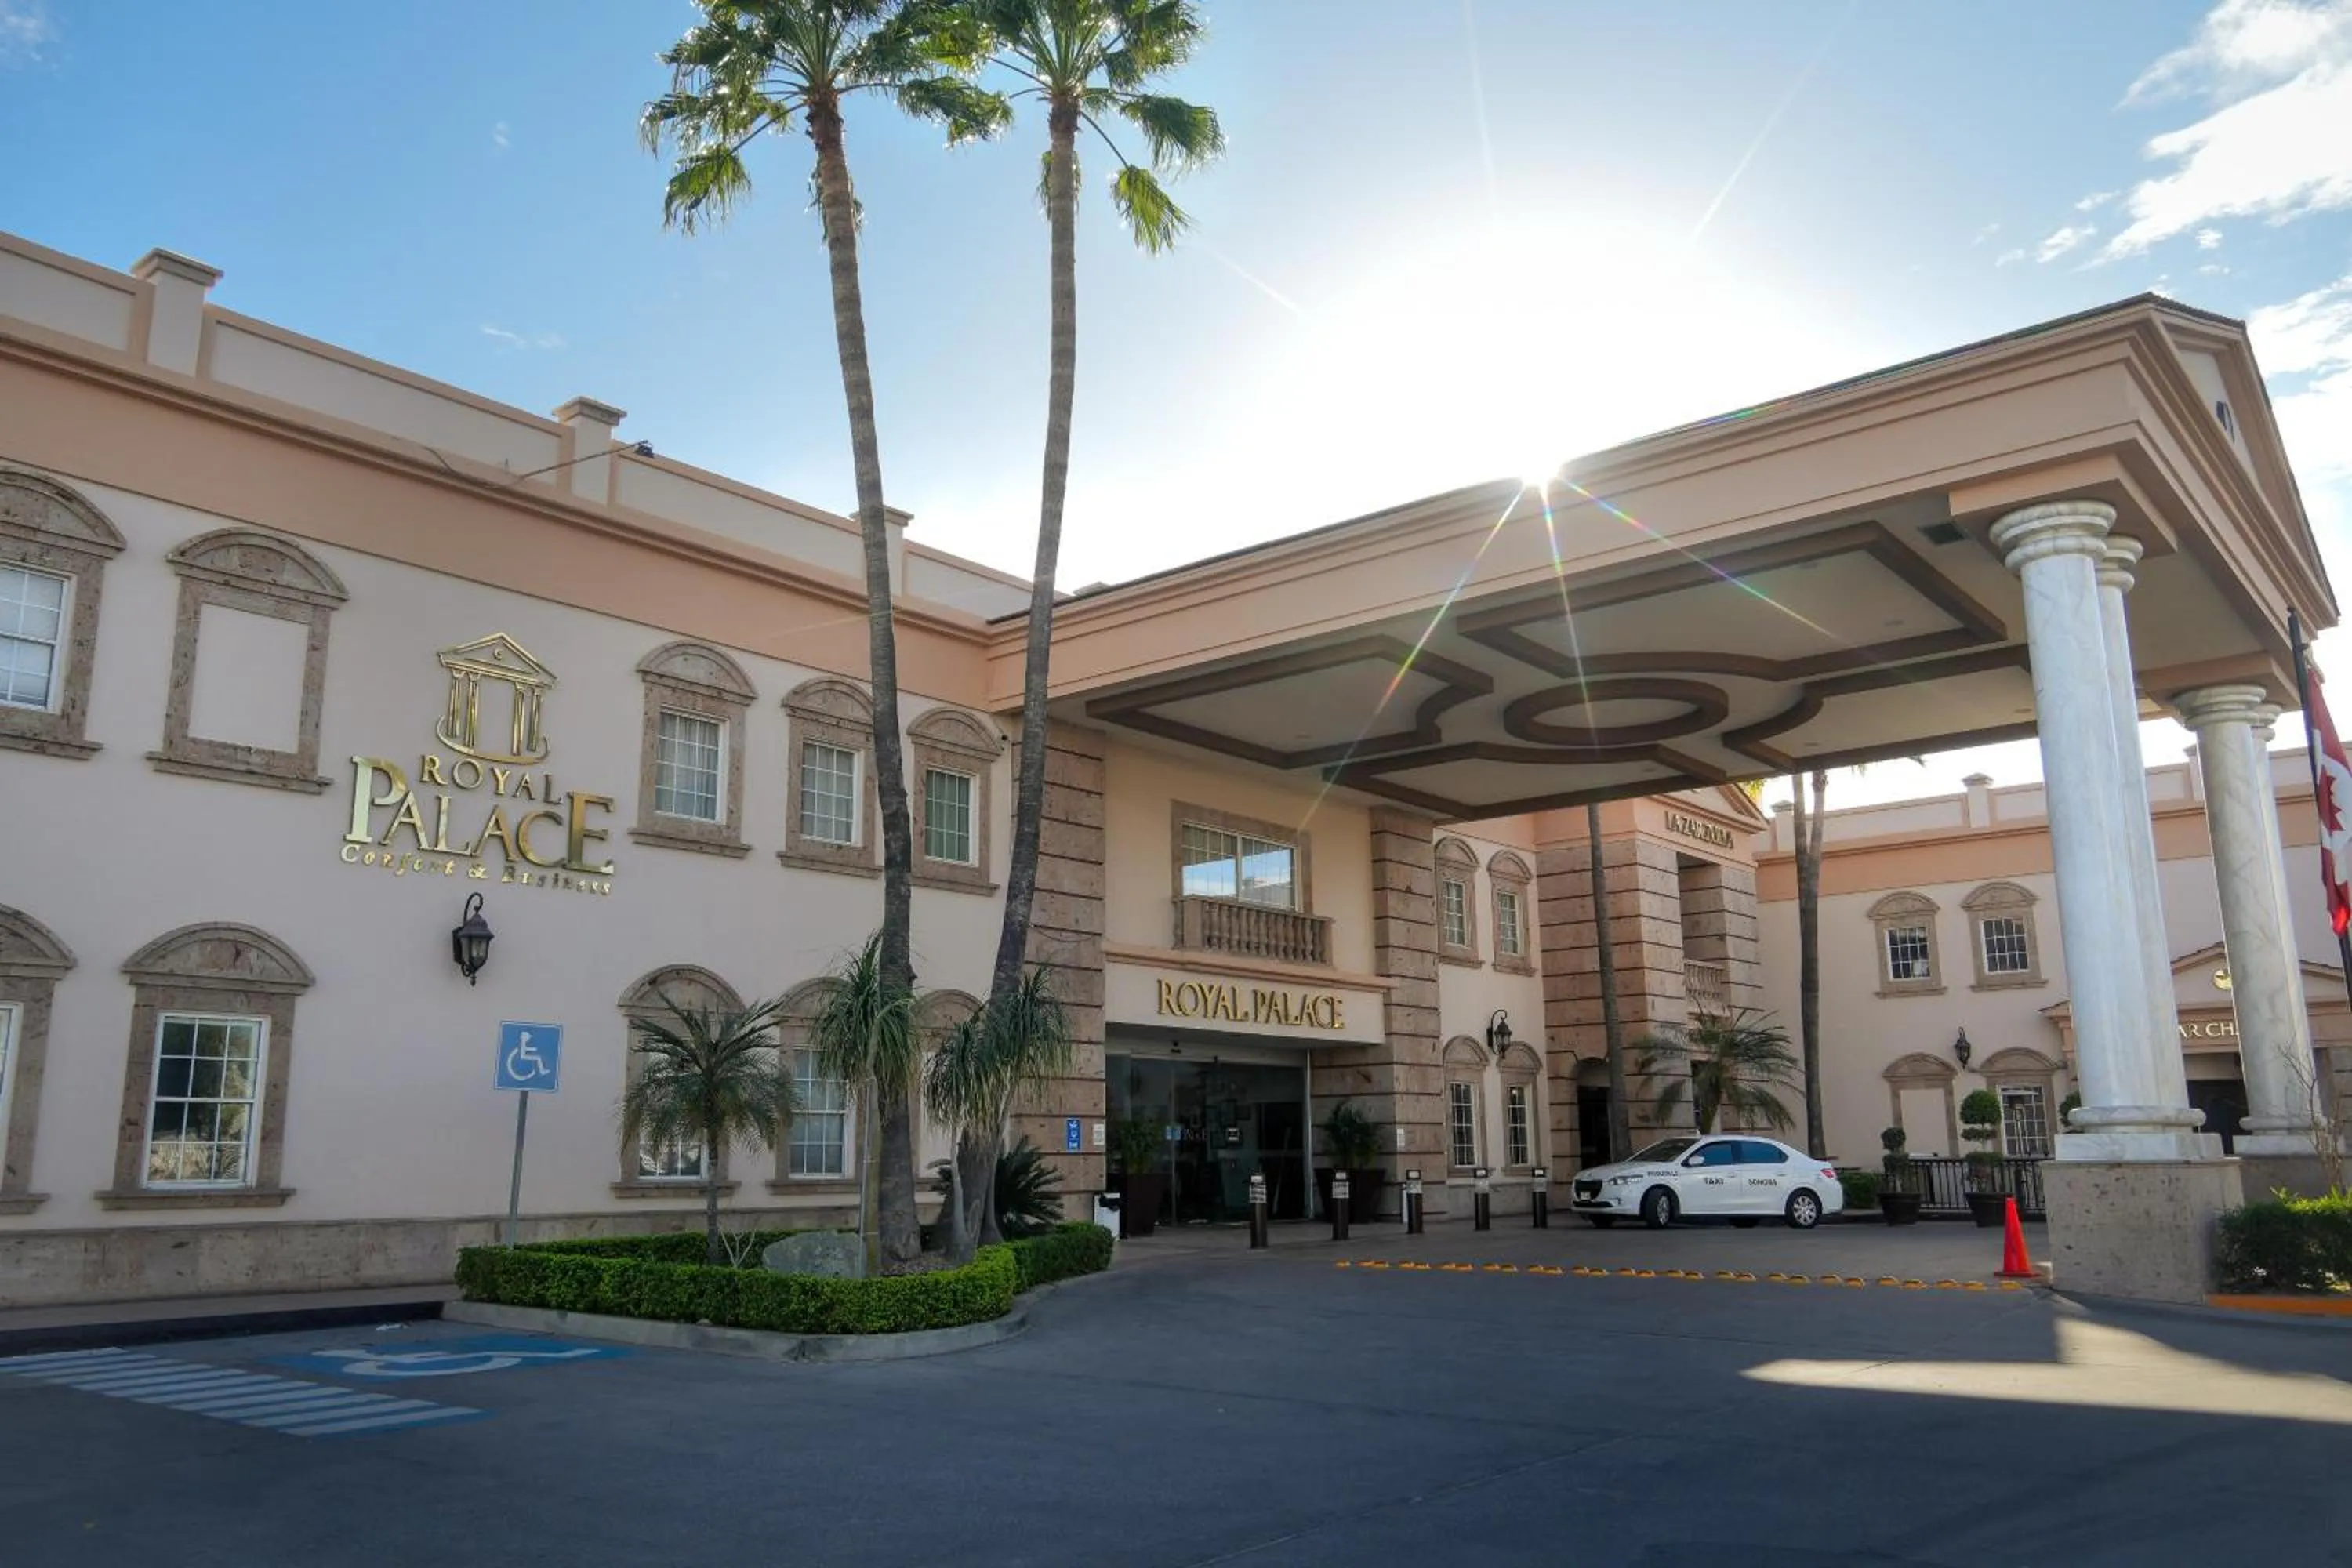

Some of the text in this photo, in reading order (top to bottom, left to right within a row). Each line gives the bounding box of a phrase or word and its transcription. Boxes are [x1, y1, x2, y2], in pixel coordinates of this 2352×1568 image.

[419, 754, 564, 804] ROYAL
[343, 756, 615, 874] PALACE
[468, 863, 488, 879] &
[1157, 979, 1343, 1029] ROYAL PALACE
